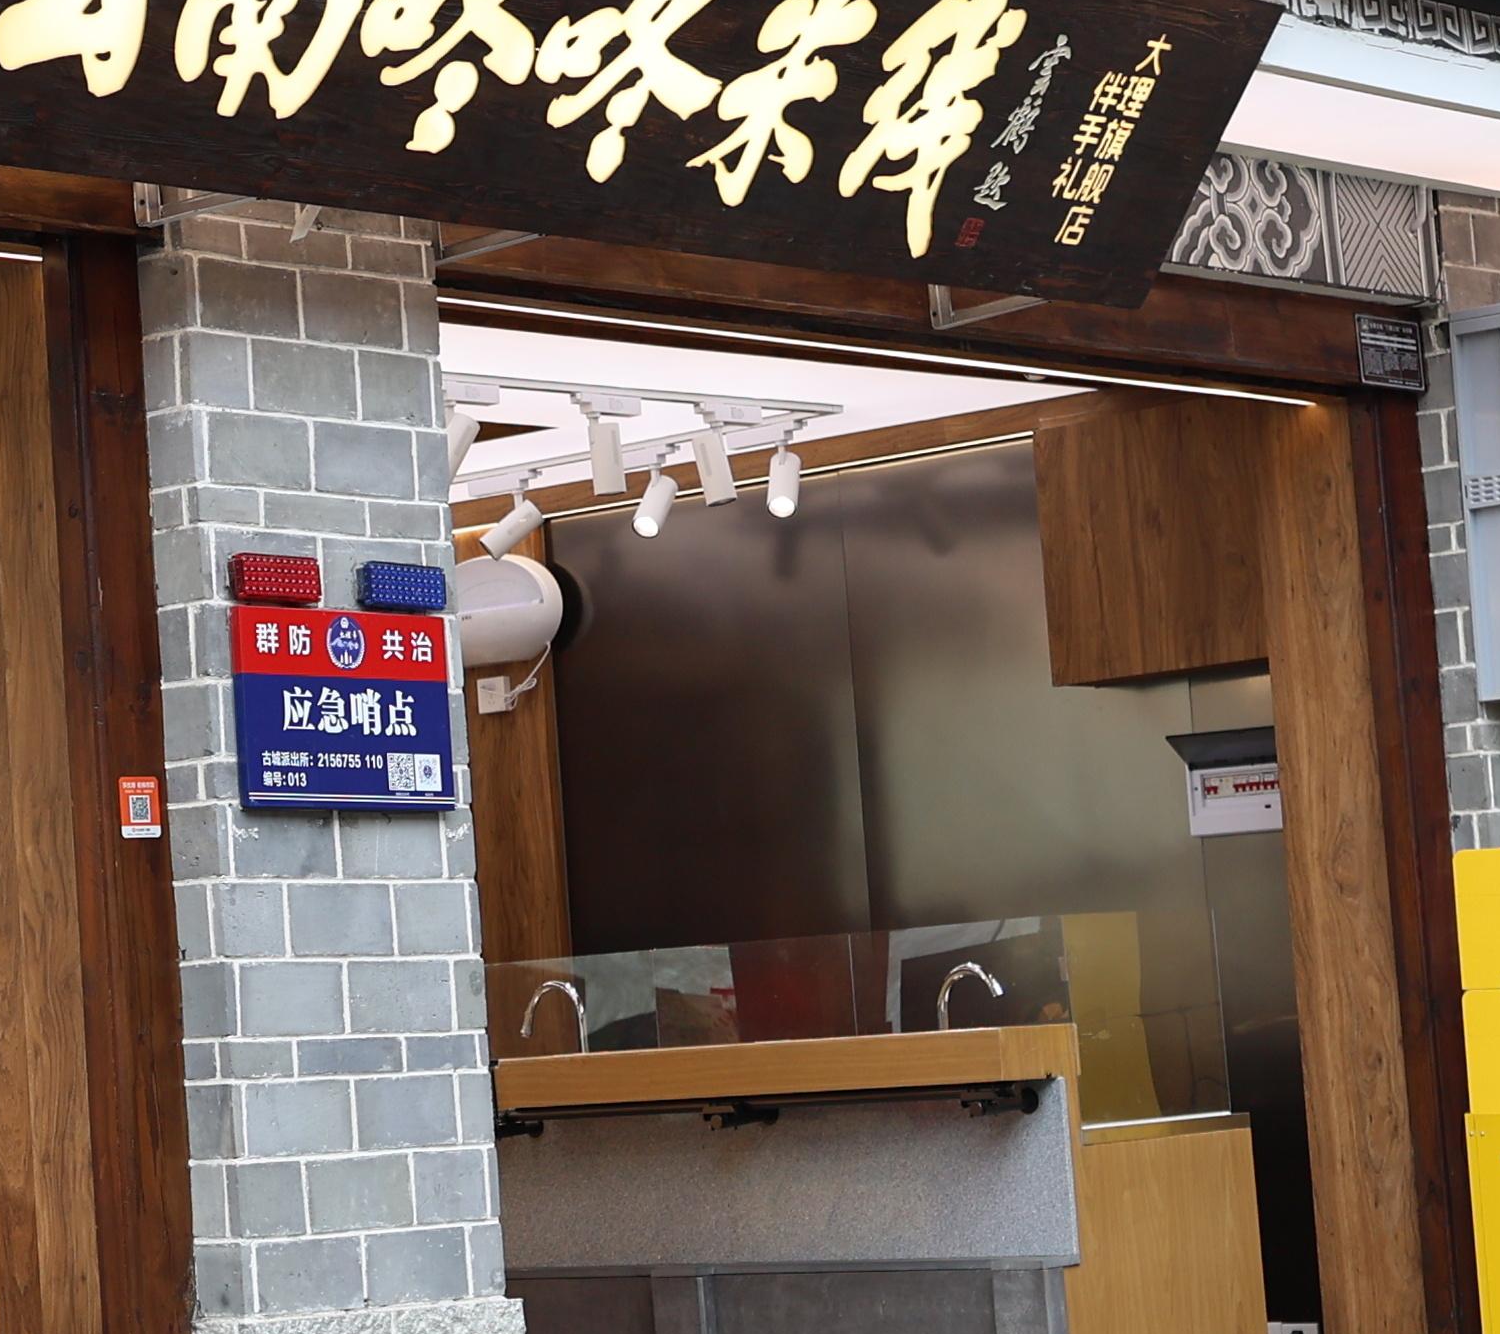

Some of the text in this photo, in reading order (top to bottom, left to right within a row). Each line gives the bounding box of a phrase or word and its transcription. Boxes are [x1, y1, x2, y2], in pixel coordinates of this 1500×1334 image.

[1052, 70, 1127, 200] 伴手礼
[1054, 33, 1172, 246] 大理旗舰店
[255, 622, 433, 663] 群防 共治
[282, 686, 418, 737] 应急哨点
[317, 751, 362, 769] 2156755
[364, 754, 384, 770] 110
